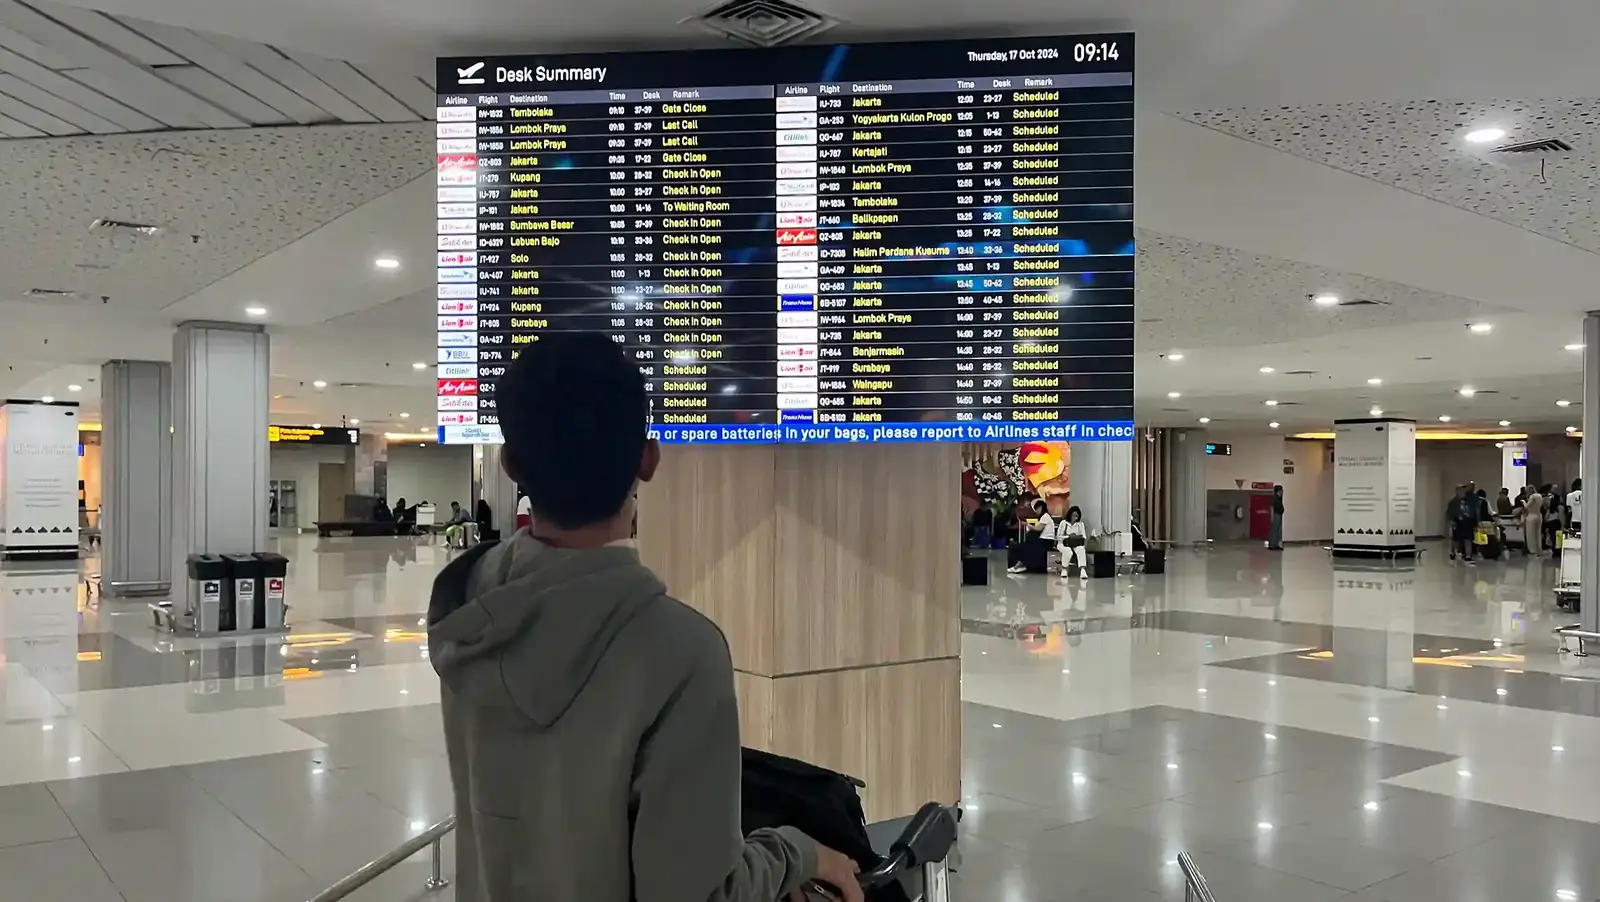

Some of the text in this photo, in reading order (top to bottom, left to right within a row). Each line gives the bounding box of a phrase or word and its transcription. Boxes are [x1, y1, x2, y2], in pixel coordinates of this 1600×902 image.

[967, 48, 1058, 62] Thursday, 17 Oct 2024
[1074, 42, 1119, 62] 09:14
[496, 66, 607, 83] Desk Summary
[785, 78, 1053, 95] Airline Flight Destination Time Desk Remark
[446, 90, 700, 105] Airline Flight Destination Time Desk Remark
[852, 91, 1059, 107] Jakarta Scheduled
[510, 103, 706, 117] Tambolaka Gate Close
[852, 108, 1058, 125] Yogyakarta Kulon Progo Scheduled
[510, 120, 698, 134] Lombok Praya Last Call
[852, 125, 1058, 140] Jakarta Scheduled
[510, 136, 698, 150] Lombok Praya Last Call
[852, 142, 1058, 158] Kertajati Scheduled
[510, 152, 706, 166] Jakarta Gate Close
[852, 158, 1058, 174] Lombok Praya Scheduled
[510, 172, 540, 183] Kupang
[663, 169, 689, 178] Check
[700, 168, 721, 179] Open
[852, 176, 1058, 190] Jakarta Scheduled
[510, 188, 538, 198] Jakarta
[663, 185, 689, 195] Check
[700, 185, 721, 196] Open
[852, 192, 1058, 206] Tambolaka Scheduled
[510, 201, 730, 214] Jakarta To Waiting Room
[852, 209, 1058, 224] Balikpapan Scheduled
[510, 220, 549, 230] Sumbawa
[551, 220, 574, 229] Besar
[635, 220, 653, 228] 37-39
[663, 218, 689, 228] Check
[700, 218, 721, 228] Open
[852, 230, 881, 240] Jakarta
[1012, 226, 1058, 236] Scheduled
[510, 237, 540, 246] Labuan
[541, 236, 560, 247] Bajo
[663, 234, 689, 244] Check
[700, 234, 721, 244] Open
[511, 254, 529, 263] Solo
[663, 252, 689, 260] Check
[700, 251, 721, 262] Open
[853, 243, 1059, 257] Halim Perdana Kusuma Scheduled
[511, 270, 539, 279] Jakarta
[664, 268, 690, 277] Check
[700, 268, 722, 278] Open
[853, 260, 1059, 274] Jakarta Scheduled
[511, 286, 539, 295] Jakarta
[664, 284, 690, 294] Check
[700, 284, 722, 294] Open
[853, 276, 1059, 290] Jakarta Scheduled
[511, 302, 541, 312] Kupang
[664, 300, 690, 310] Check
[700, 300, 722, 310] Open
[853, 293, 1059, 306] Jakarta Scheduled
[511, 318, 547, 328] Surabaya
[664, 317, 690, 326] Check
[700, 316, 722, 327] Open
[853, 310, 1058, 324] Lombok Praya Scheduled
[664, 333, 690, 342] Check
[701, 333, 722, 343] Open
[853, 327, 1058, 340] Jakarta Scheduled
[664, 349, 690, 358] Check
[701, 349, 722, 359] Open
[853, 344, 1058, 358] Banjarmasin Scheduled
[664, 365, 706, 374] Scheduled
[852, 360, 1058, 374] Surabaya Scheduled
[664, 382, 706, 391] Scheduled
[852, 377, 1058, 390] Waingapu Scheduled
[664, 398, 706, 407] Scheduled
[852, 394, 1058, 405] Jakarta Scheduled
[664, 414, 706, 423] Scheduled
[852, 410, 1058, 422] Jakarta Scheduled
[664, 430, 678, 440] or
[681, 430, 717, 442] spare
[722, 427, 782, 440] batteries
[801, 429, 830, 442] your
[835, 426, 869, 441] bags,
[873, 426, 917, 441] please
[922, 427, 963, 440] report
[967, 426, 981, 438] to
[985, 425, 1039, 438] Airlines
[1043, 424, 1077, 437] staff
[1098, 424, 1134, 437] chec
